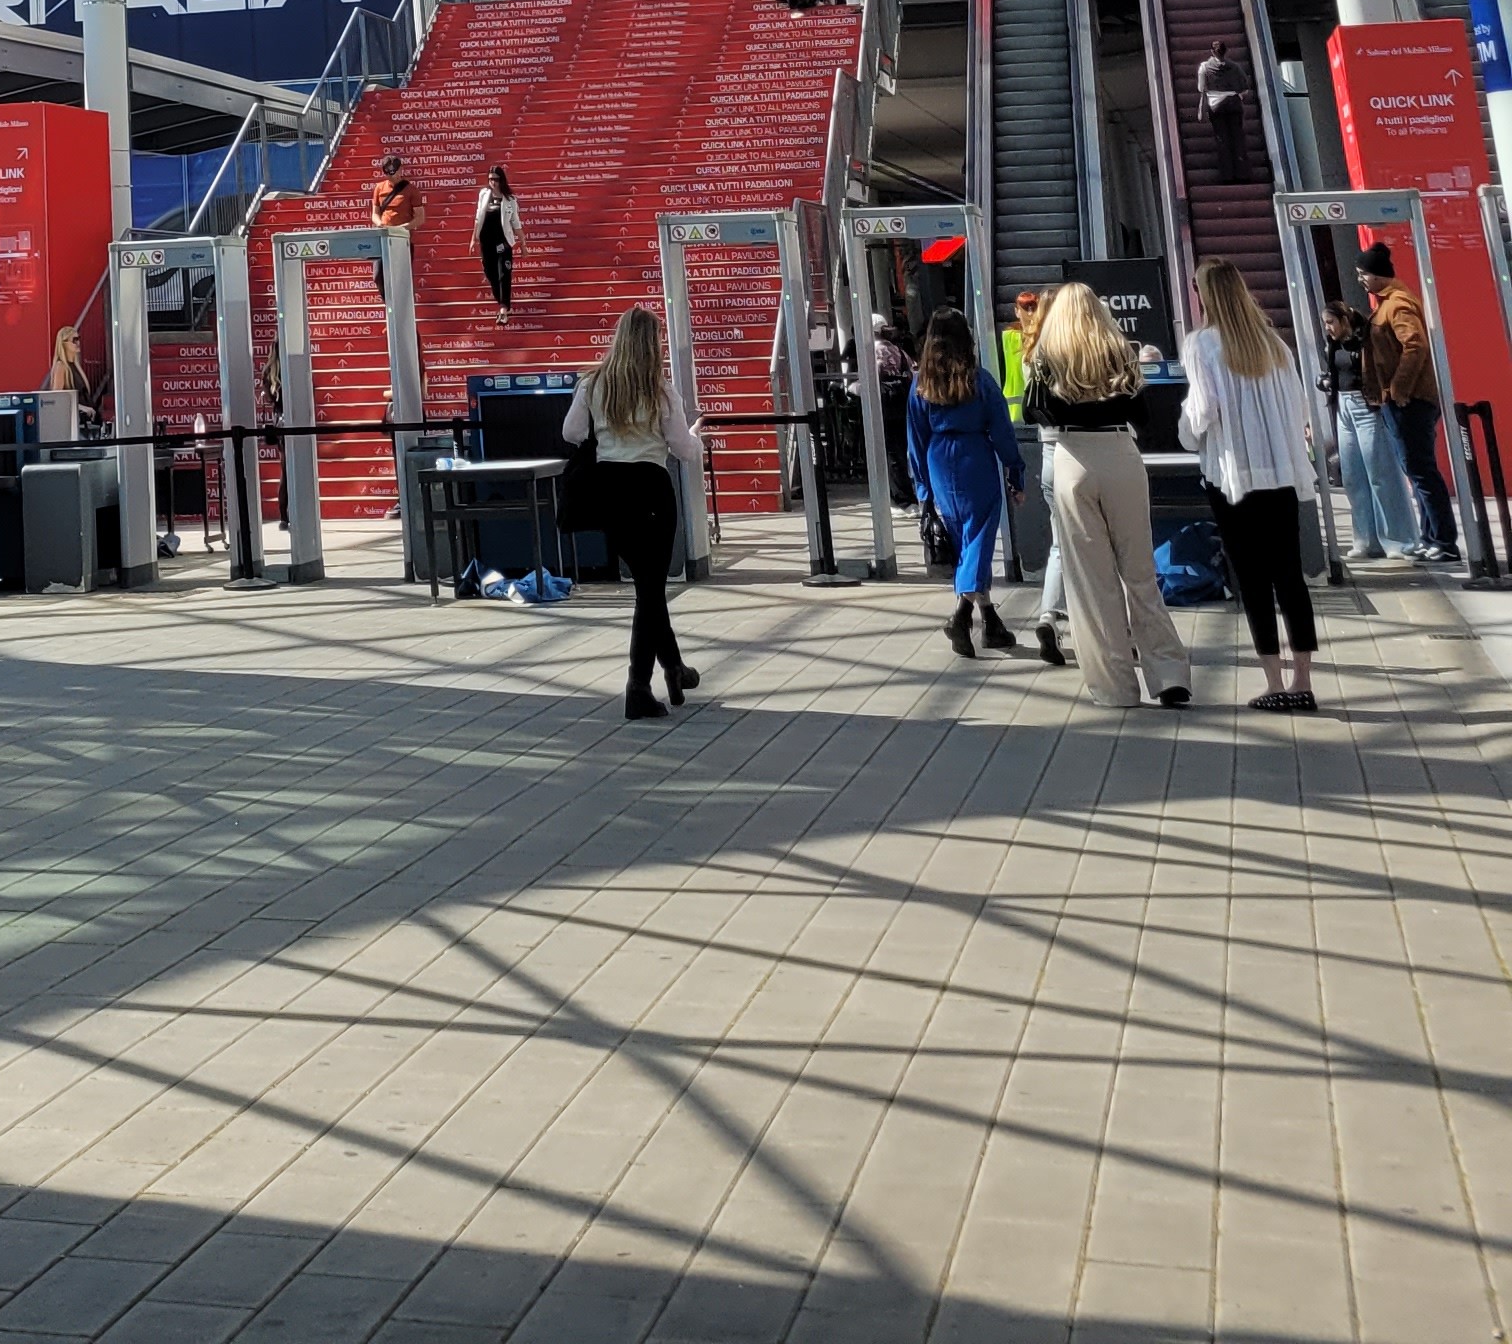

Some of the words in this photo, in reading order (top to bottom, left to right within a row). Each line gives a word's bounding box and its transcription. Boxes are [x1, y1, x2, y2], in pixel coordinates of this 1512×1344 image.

[1370, 96, 1419, 110] QUICK
[1420, 94, 1455, 107] LINK
[1376, 117, 1383, 125] A
[381, 135, 403, 143] QUICK
[0, 168, 25, 179] LINK
[660, 184, 687, 192] QUICK
[688, 183, 707, 191] LINK
[708, 182, 715, 190] A
[716, 181, 740, 190] TUTTI
[746, 179, 793, 189] PADIGLIONI
[665, 196, 691, 206] QUICK
[693, 196, 710, 204] LINK
[712, 195, 723, 203] TO
[725, 194, 740, 203] ALL
[741, 193, 783, 202] PAVILIONS
[693, 299, 719, 308] TUTTI
[725, 297, 776, 306] PADIGLIONI
[337, 311, 384, 319] PADIGLIONI
[163, 381, 191, 390] QUICK
[193, 380, 213, 389] LINK
